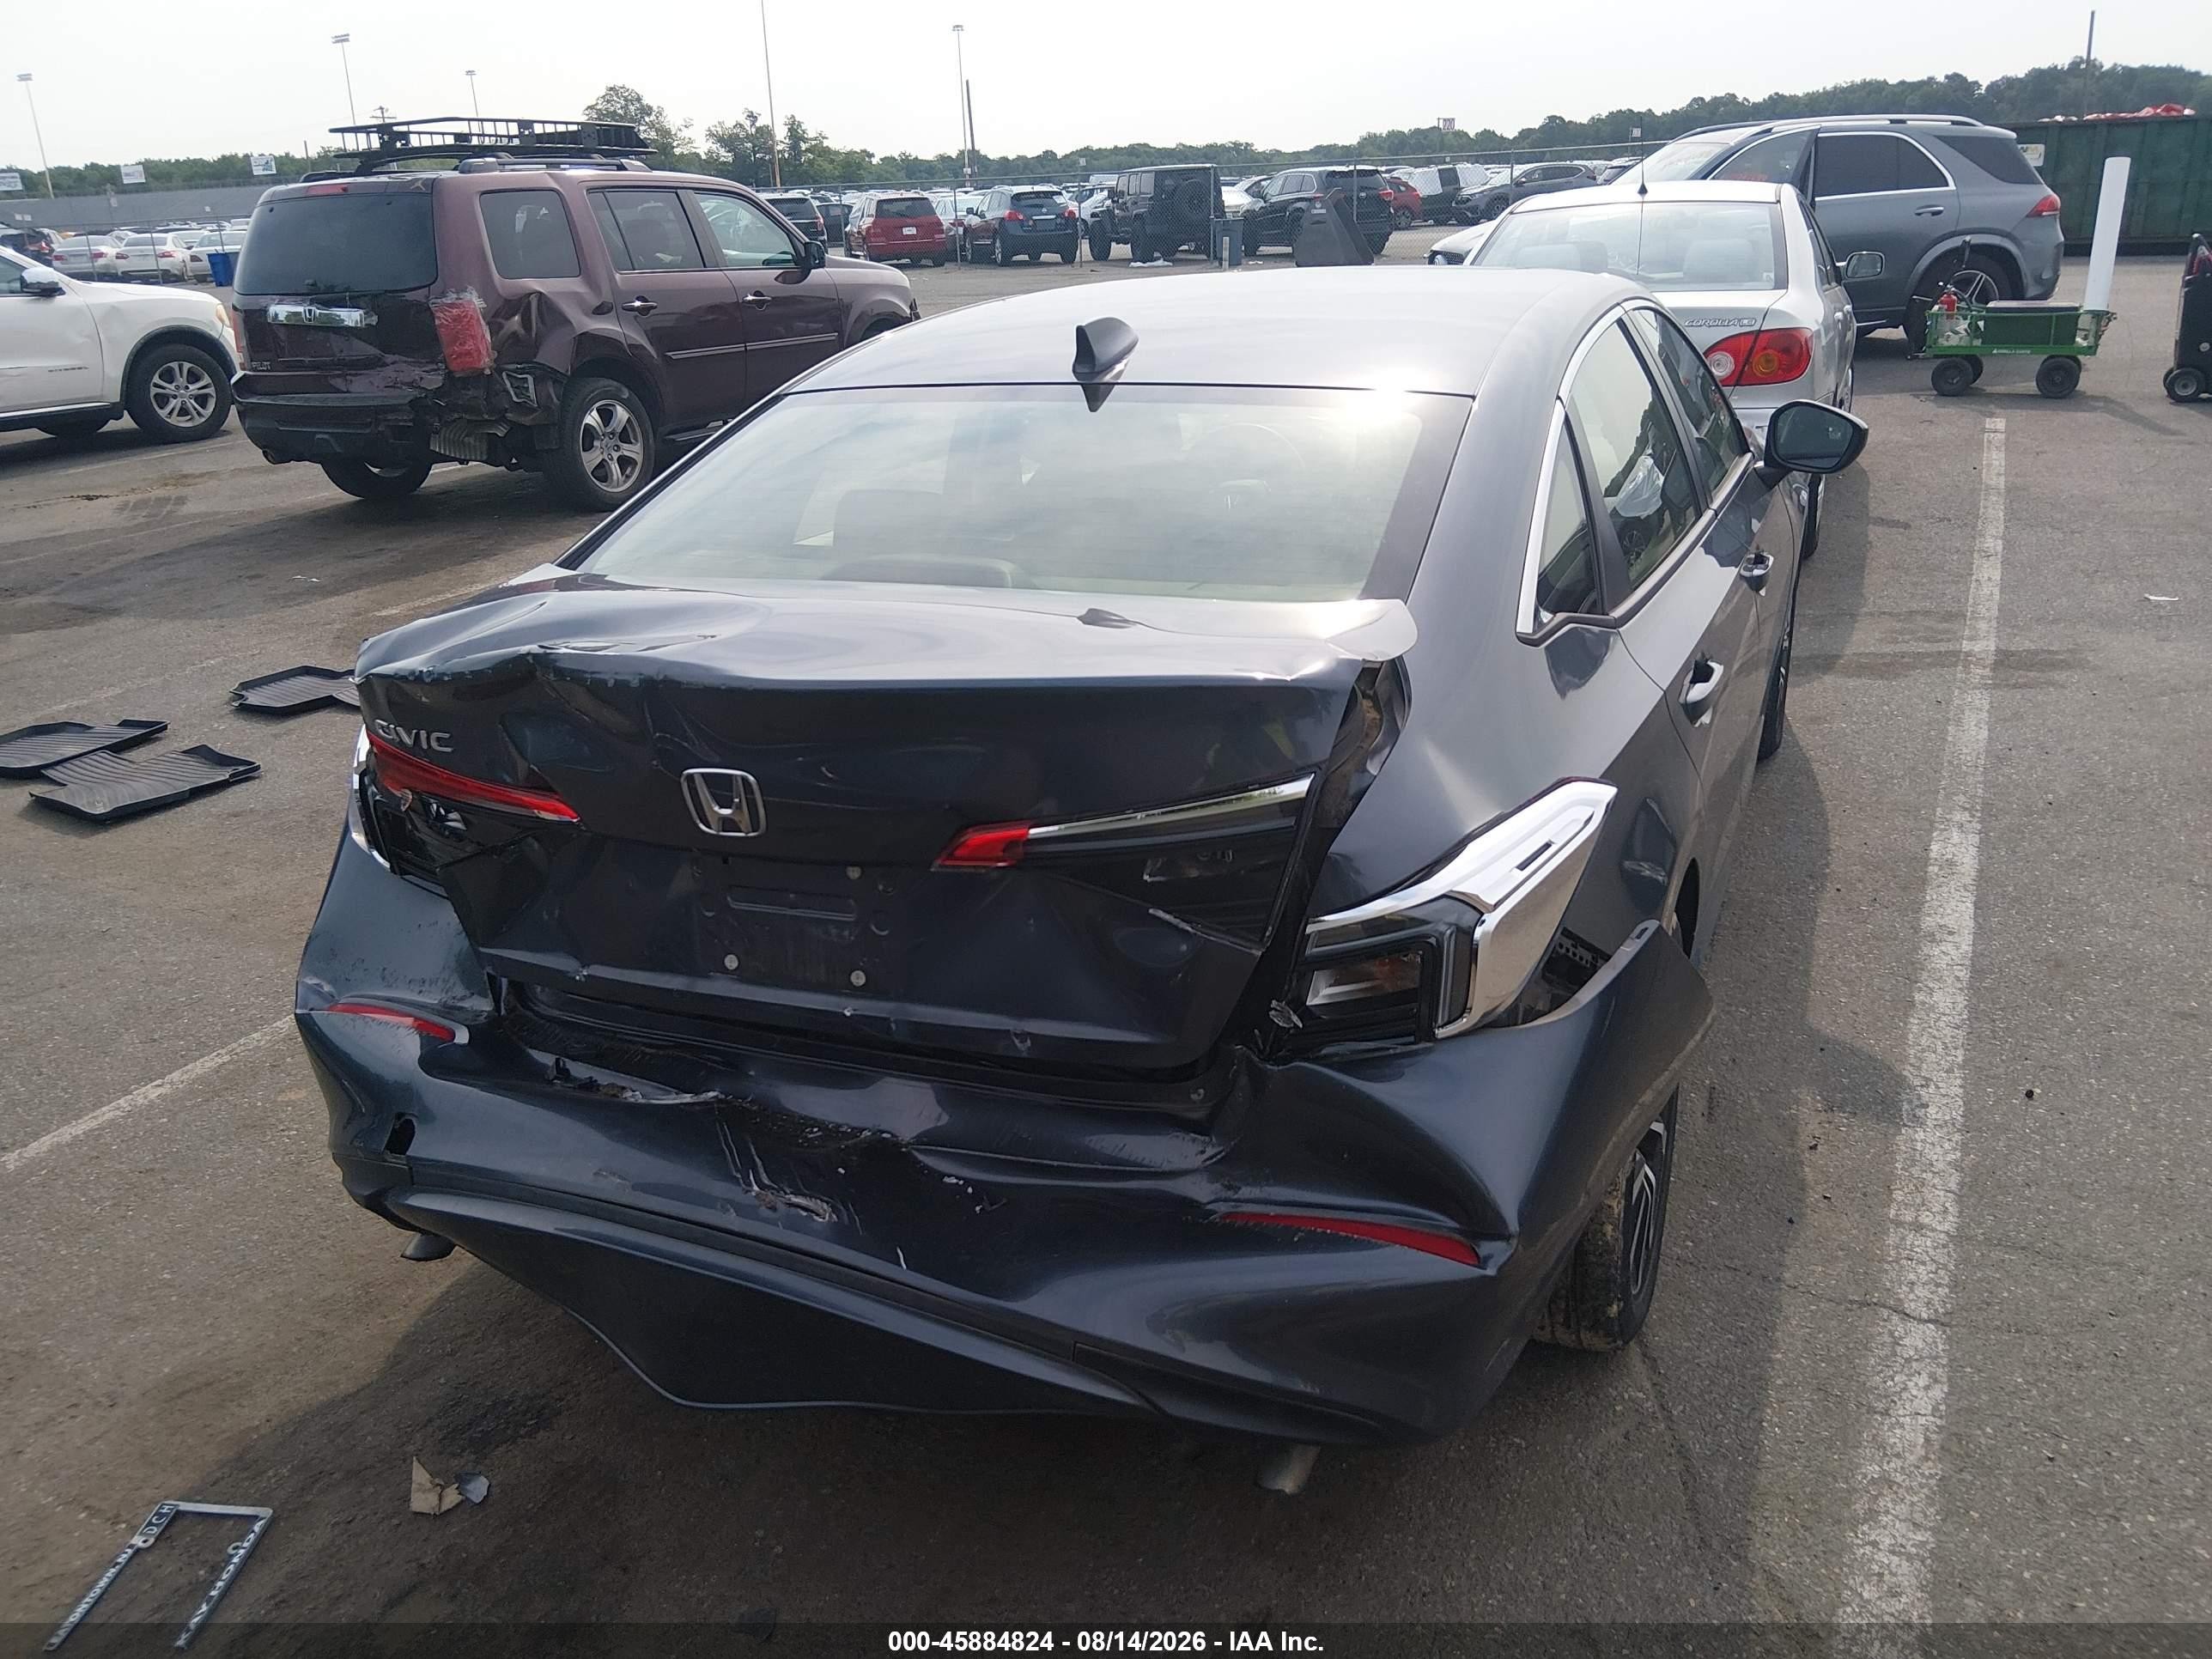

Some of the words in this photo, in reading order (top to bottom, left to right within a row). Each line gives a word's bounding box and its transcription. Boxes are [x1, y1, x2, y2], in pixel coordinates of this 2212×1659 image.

[1684, 318, 1739, 327] COROLLA
[374, 719, 453, 752] CIVIC
[143, 1504, 175, 1535] DCH
[210, 1518, 268, 1597] HONDA
